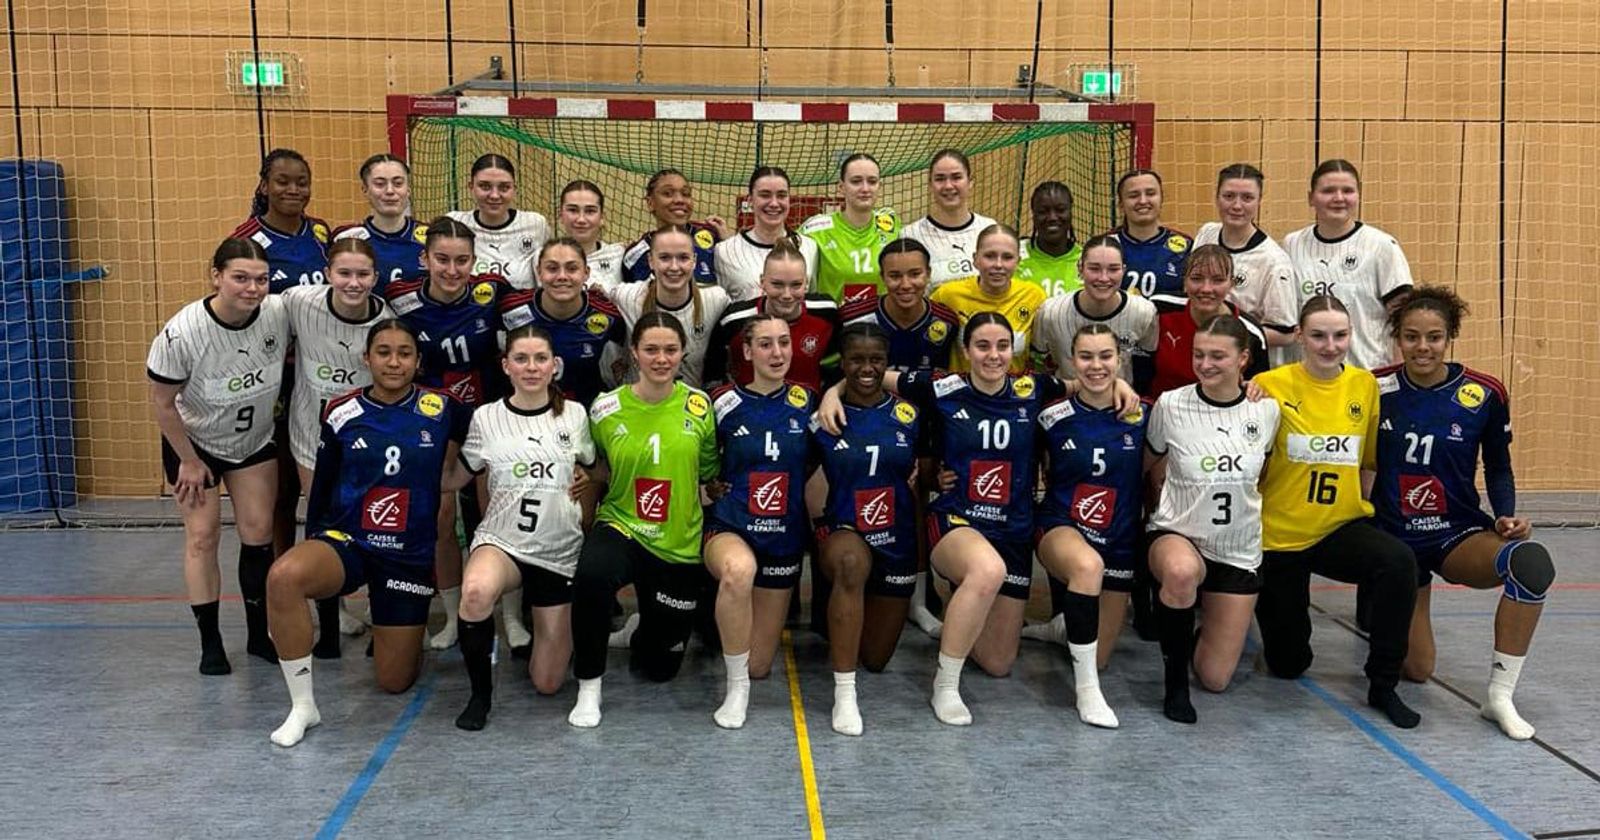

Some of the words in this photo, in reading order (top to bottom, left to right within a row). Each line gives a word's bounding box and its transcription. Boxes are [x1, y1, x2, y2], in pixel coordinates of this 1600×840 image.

[850, 248, 873, 274] 12
[947, 260, 973, 275] ea
[1041, 278, 1066, 299] 16
[1127, 271, 1157, 296] 20
[441, 335, 470, 364] 11
[228, 370, 264, 392] eak
[316, 363, 357, 386] eak
[235, 405, 255, 433] 9
[648, 433, 660, 465] 1
[764, 431, 780, 462] 4
[977, 419, 1011, 451] 10
[1309, 436, 1350, 453] eak
[1404, 432, 1434, 465] 21
[384, 446, 401, 476] 8
[512, 461, 556, 479] eak
[866, 445, 880, 477] 7
[1091, 447, 1106, 477] 5
[1200, 455, 1244, 473] eak
[1306, 470, 1339, 505] 16
[517, 498, 541, 533] 5
[1211, 492, 1232, 526] 3
[1411, 516, 1442, 525] CAISSE
[367, 533, 398, 542] CAISSE
